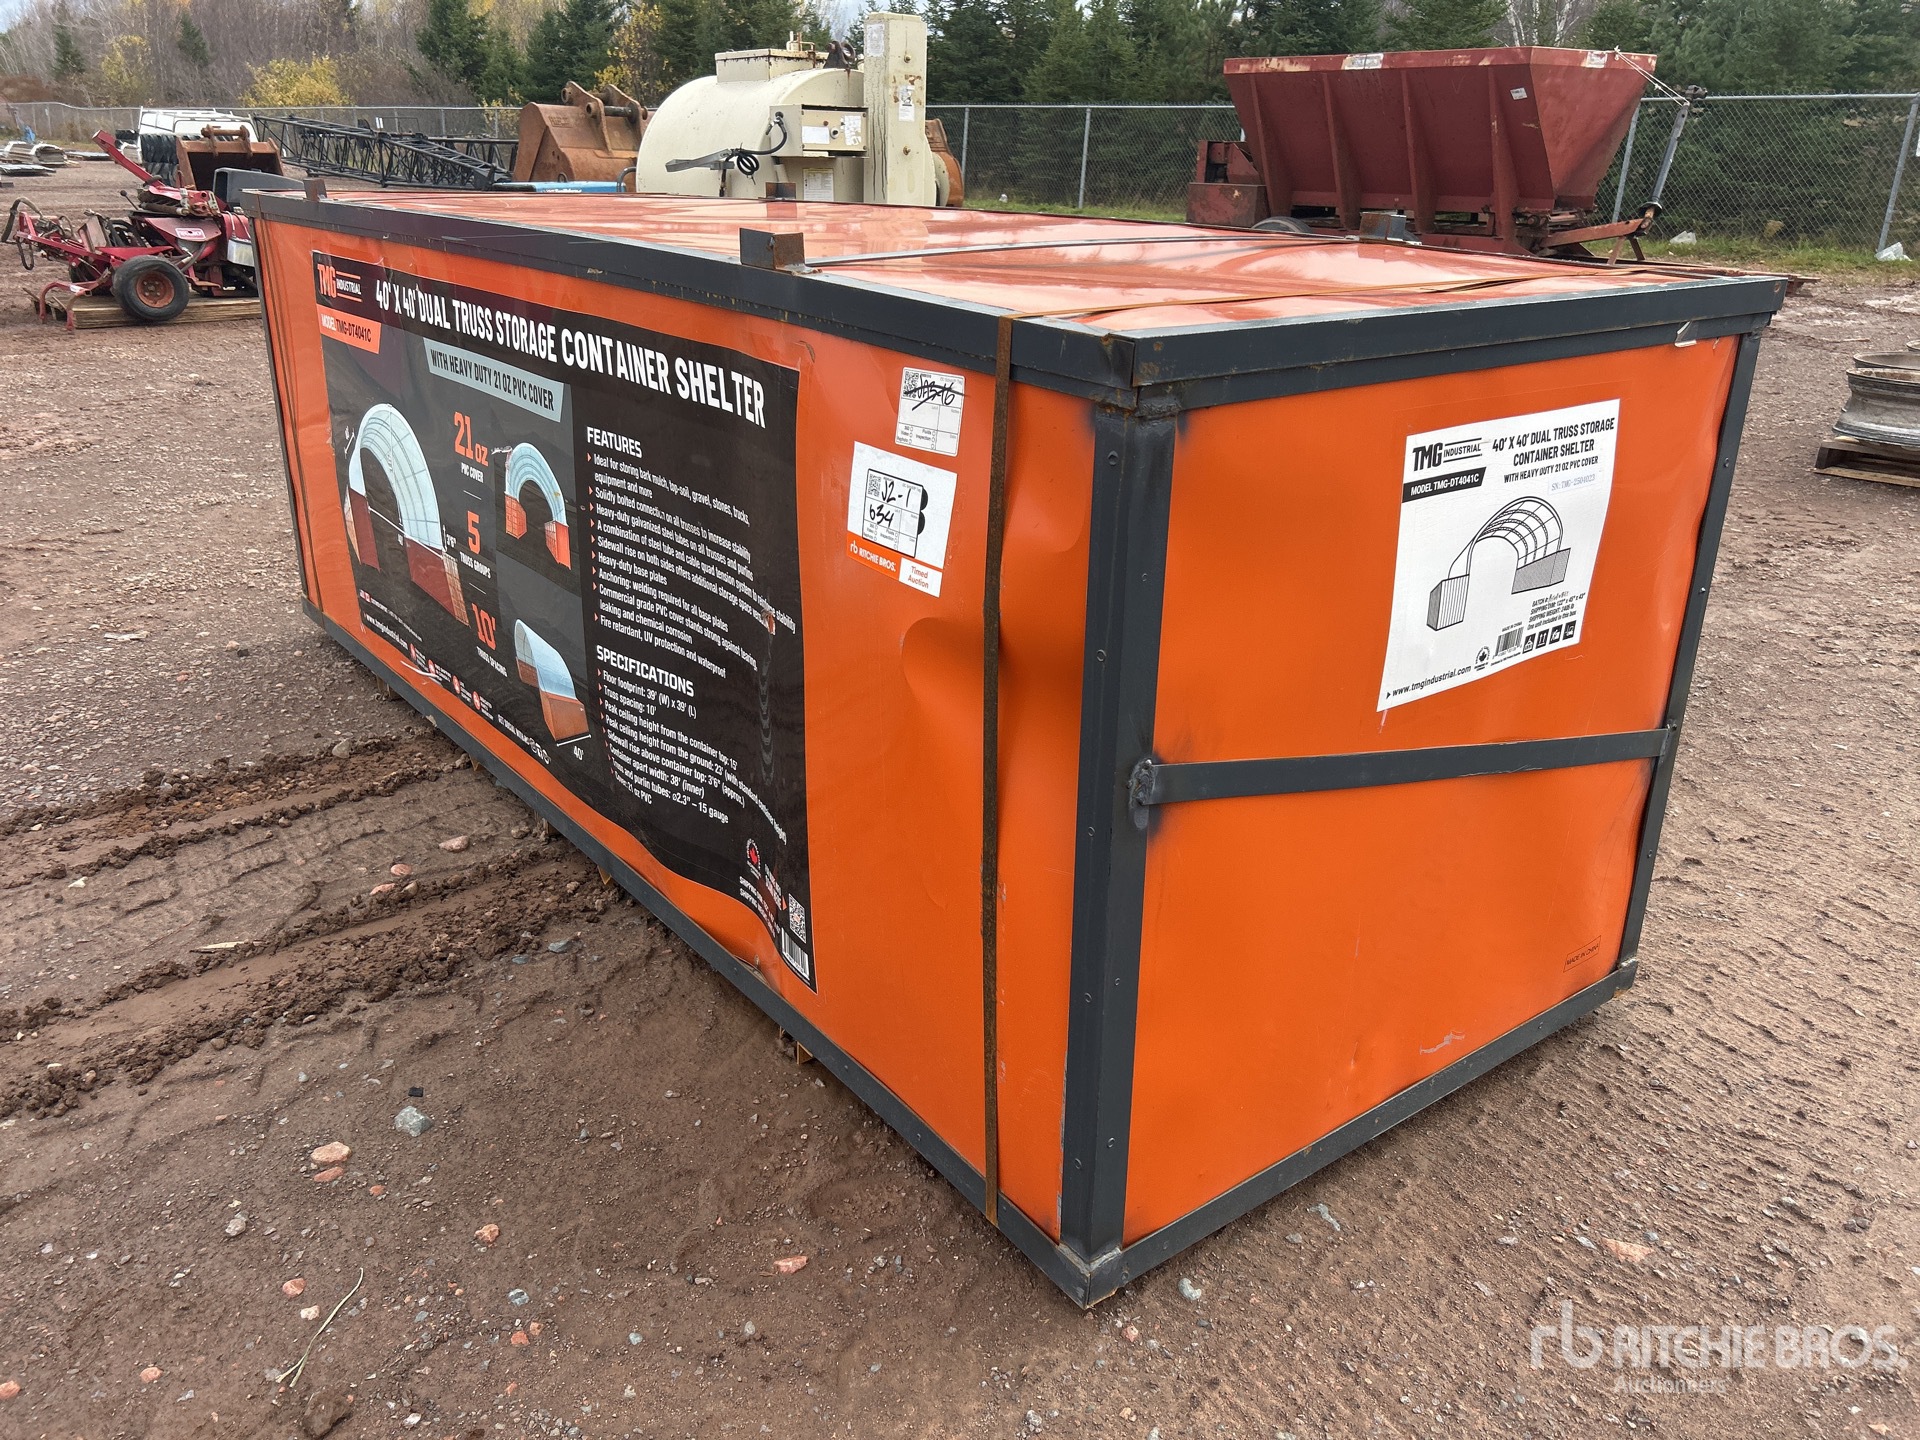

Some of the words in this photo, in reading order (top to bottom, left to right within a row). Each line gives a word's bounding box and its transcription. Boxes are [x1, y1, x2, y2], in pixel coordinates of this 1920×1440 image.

[317, 263, 337, 299] TMG
[336, 278, 362, 295] INDUSTRIAL
[320, 314, 337, 331] MODEL
[335, 319, 372, 343] TMG-DT4041C
[375, 279, 393, 312] 40'
[393, 289, 402, 315] X
[402, 287, 418, 320] 40'
[418, 291, 451, 330] DUAL
[452, 299, 494, 342] TRUSS
[495, 310, 558, 363] STORAGE
[560, 328, 672, 395] CONTAINER
[674, 357, 766, 429] SHELTER
[430, 349, 449, 371] WITH
[449, 355, 473, 379] HEAVY
[474, 363, 492, 387] DUTY
[493, 370, 501, 390] 21
[502, 373, 512, 394] OZ
[512, 377, 527, 400] PVC
[528, 383, 554, 411] COVER
[453, 411, 473, 461] 21
[586, 426, 643, 459] FEATURES
[1492, 437, 1508, 452] 40'
[1508, 436, 1515, 450] X
[1516, 433, 1530, 448] 40'
[1530, 429, 1552, 446] DUAL
[1553, 424, 1579, 441] TRUSS
[1579, 417, 1615, 436] STORAGE
[1412, 442, 1443, 472] TMG
[1443, 443, 1481, 458] INDUSTRIAL
[1503, 473, 1519, 484] WITH
[1519, 468, 1539, 481] HEAVY
[1539, 464, 1555, 476] DUTY
[1555, 463, 1561, 473] 21
[1561, 461, 1569, 472] OZ
[1569, 459, 1581, 470] PVC
[1581, 455, 1599, 467] COVER
[1513, 445, 1559, 467] CONTAINER
[1559, 438, 1595, 457] SHELTER
[460, 462, 470, 478] PVC
[470, 465, 484, 484] COVER
[593, 453, 609, 468] Ideal
[609, 457, 619, 471] for
[619, 461, 640, 480] storing
[638, 466, 652, 482] bark
[651, 474, 670, 492] mulch,
[668, 479, 692, 502] top-soil,
[691, 490, 713, 509] gravel,
[712, 497, 733, 518] stones,
[594, 472, 627, 490] equipment
[626, 482, 638, 494] and
[638, 485, 653, 499] more
[1410, 483, 1433, 497] MODEL
[1433, 473, 1480, 492] TMG-DT4041C
[467, 510, 481, 555] 5
[473, 560, 491, 579] GROUPS
[598, 551, 633, 575] Heavy-duty
[633, 562, 649, 578] base
[648, 570, 668, 586] plates
[859, 547, 878, 565] RITCHIE
[878, 554, 896, 572] BROS.
[911, 565, 928, 579] Timed
[907, 575, 929, 589] Auction
[471, 603, 497, 651] 10'
[599, 583, 635, 606] Commercial
[636, 598, 655, 613] grade
[655, 602, 668, 618] PVC
[668, 610, 685, 625] cover
[684, 617, 704, 635] stands
[703, 627, 722, 647] strong
[721, 637, 741, 657] against
[600, 598, 622, 619] leaking
[622, 609, 635, 622] and
[635, 613, 665, 632] chemical
[665, 625, 693, 645] corrosion
[1542, 616, 1558, 625] included
[600, 614, 612, 629] Fire
[612, 621, 643, 642] retardant,
[643, 630, 654, 643] UV
[654, 636, 686, 657] protection
[685, 649, 697, 662] and
[696, 654, 727, 679] waterproof
[596, 644, 695, 698] SPECIFICATIONS
[1391, 664, 1472, 697] www.tmgindustrial.com
[602, 669, 617, 685] Floor
[617, 676, 646, 697] footprint:
[646, 688, 658, 701] 39'
[658, 692, 670, 708] (W)
[671, 699, 676, 709] x
[676, 699, 687, 712] 39'
[687, 704, 697, 720] (L)
[603, 684, 619, 701] Truss
[619, 694, 645, 714] spacing:
[646, 703, 657, 716] 10'
[604, 699, 618, 716] Peak
[618, 708, 638, 726] ceiling
[638, 715, 660, 733] height
[660, 723, 677, 740] from
[677, 731, 689, 745] the
[689, 737, 718, 760] container
[718, 750, 730, 766] top:
[605, 713, 619, 730] Peak
[619, 723, 638, 741] ceiling
[638, 730, 660, 749] height
[660, 739, 677, 755] from
[677, 746, 689, 760] the
[689, 753, 714, 772] ground:
[607, 728, 629, 750] Sidewall
[629, 741, 641, 756] rise
[641, 748, 661, 764] above
[661, 757, 693, 777] container
[693, 768, 707, 784] top:
[624, 768, 634, 780] and
[634, 774, 651, 790] purlin
[651, 781, 671, 799] tubes:
[698, 801, 708, 814] 15
[708, 807, 729, 824] gauge
[632, 759, 649, 774] apart
[649, 766, 670, 783] width:
[670, 774, 681, 787] 38'
[682, 779, 705, 799] (inner)
